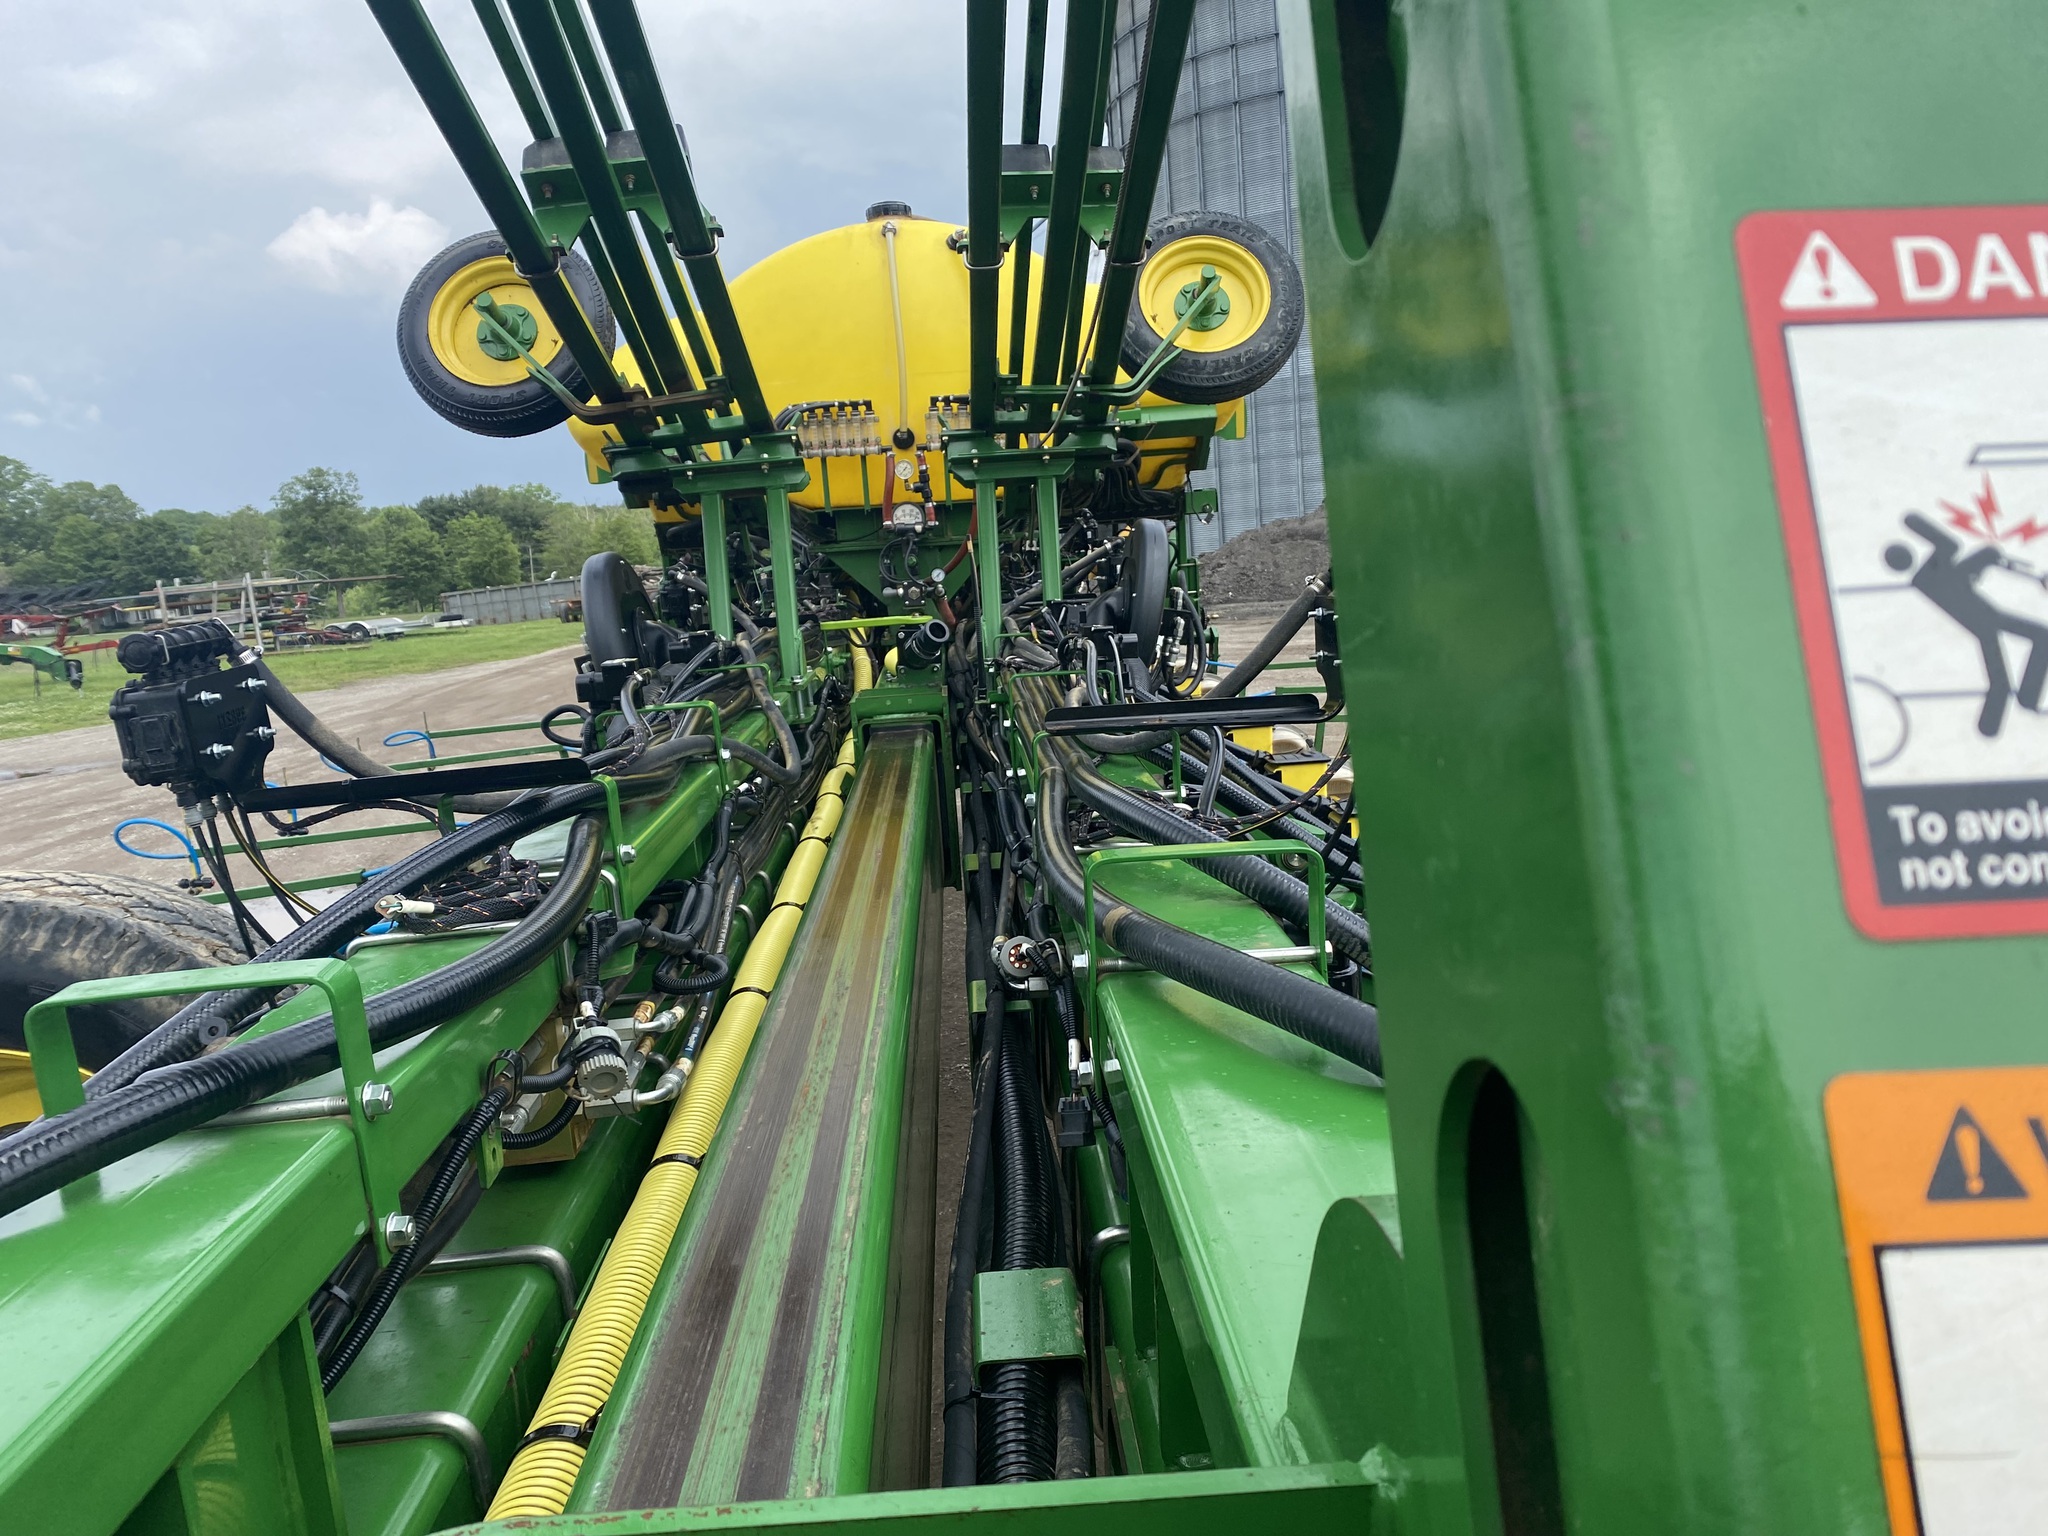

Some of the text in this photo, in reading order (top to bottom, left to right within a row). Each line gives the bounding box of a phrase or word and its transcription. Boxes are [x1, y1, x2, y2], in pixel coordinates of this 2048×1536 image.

[463, 389, 527, 407] SPORT
[1887, 798, 2048, 846] To avoi
[1899, 848, 1973, 891] not
